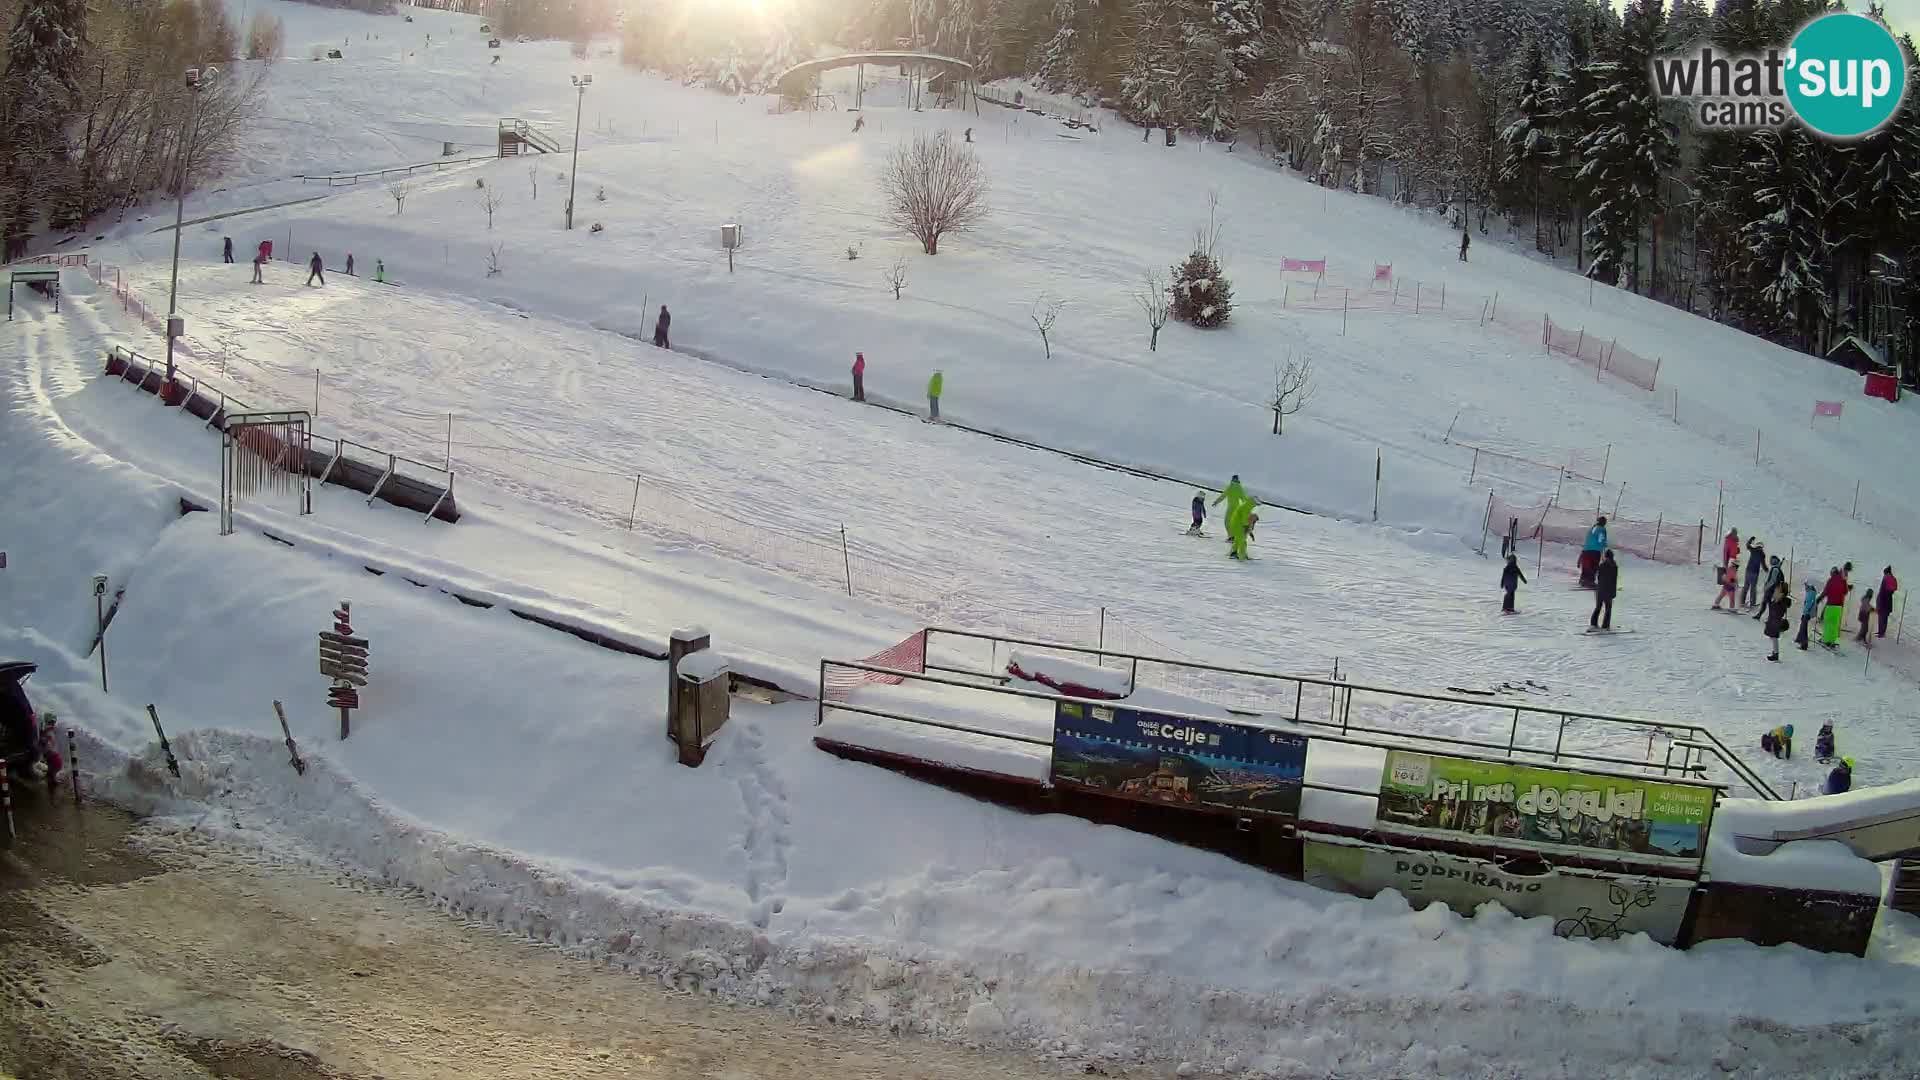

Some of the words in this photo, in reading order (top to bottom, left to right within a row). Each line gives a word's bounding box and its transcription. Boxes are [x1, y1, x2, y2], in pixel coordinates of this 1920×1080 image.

[1160, 724, 1206, 746] Celje
[1432, 778, 1470, 801] Pri
[1473, 783, 1515, 803] nas
[1516, 784, 1645, 822] dogaja!
[1395, 860, 1542, 893] PODPIRAMO
